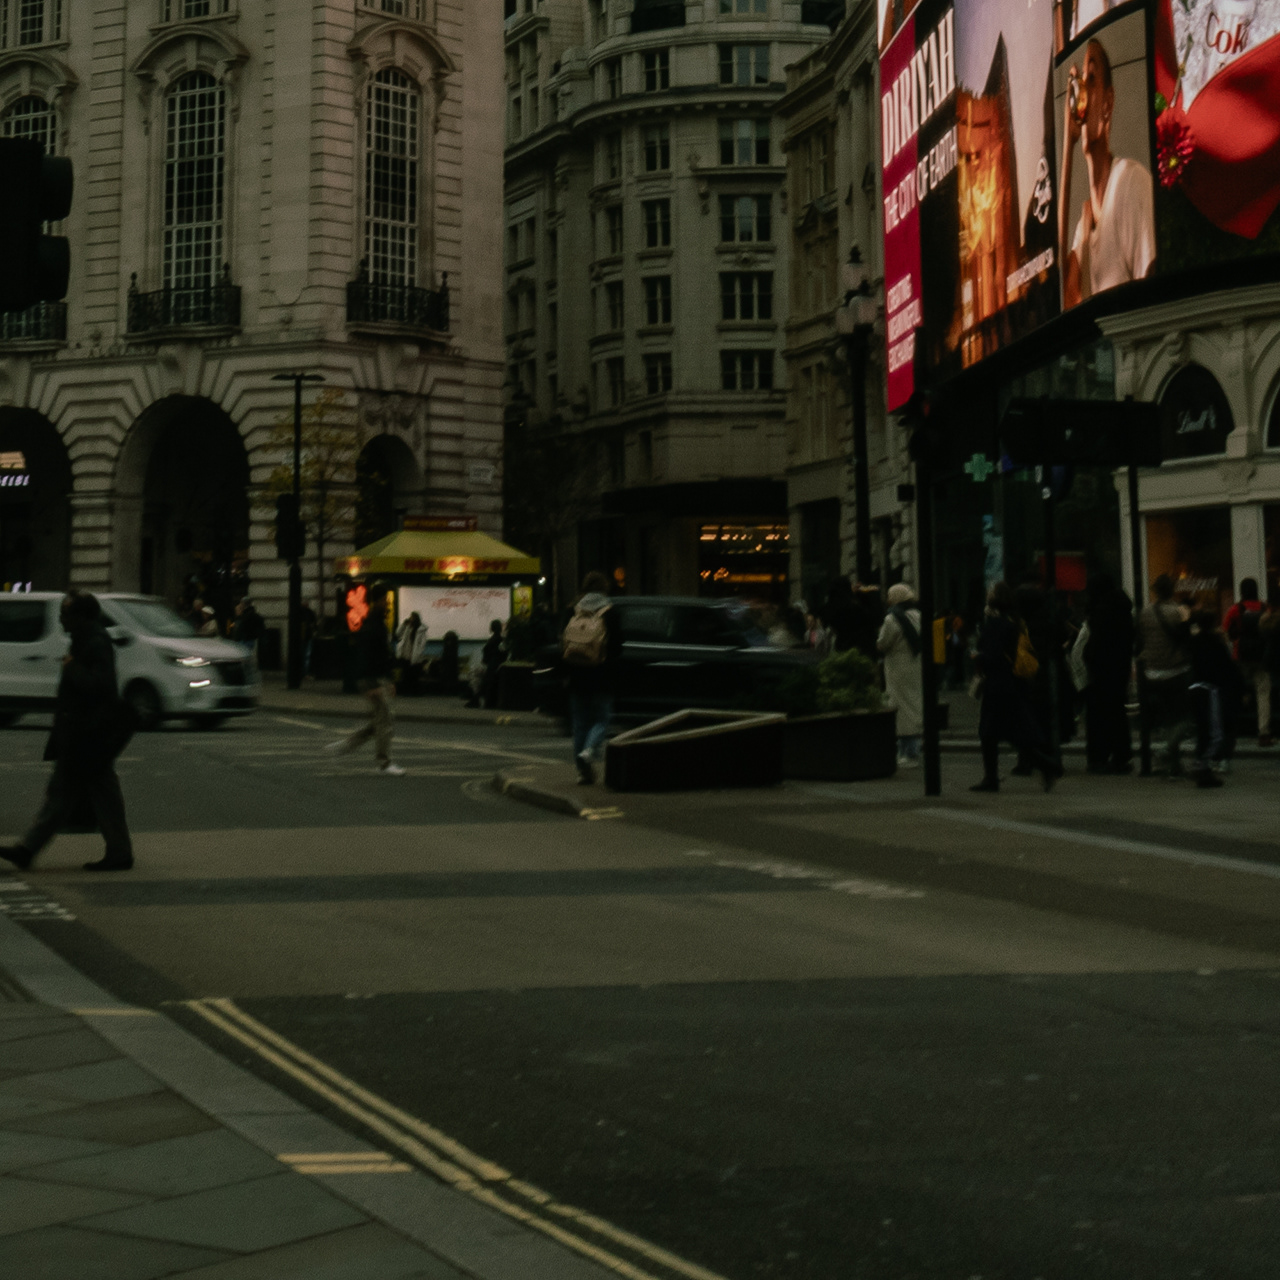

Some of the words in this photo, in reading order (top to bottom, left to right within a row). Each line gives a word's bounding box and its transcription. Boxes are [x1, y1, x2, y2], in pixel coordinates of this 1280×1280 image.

[882, 7, 956, 169] DIRIYAH
[917, 154, 930, 201] OF
[929, 124, 958, 190] EARTH
